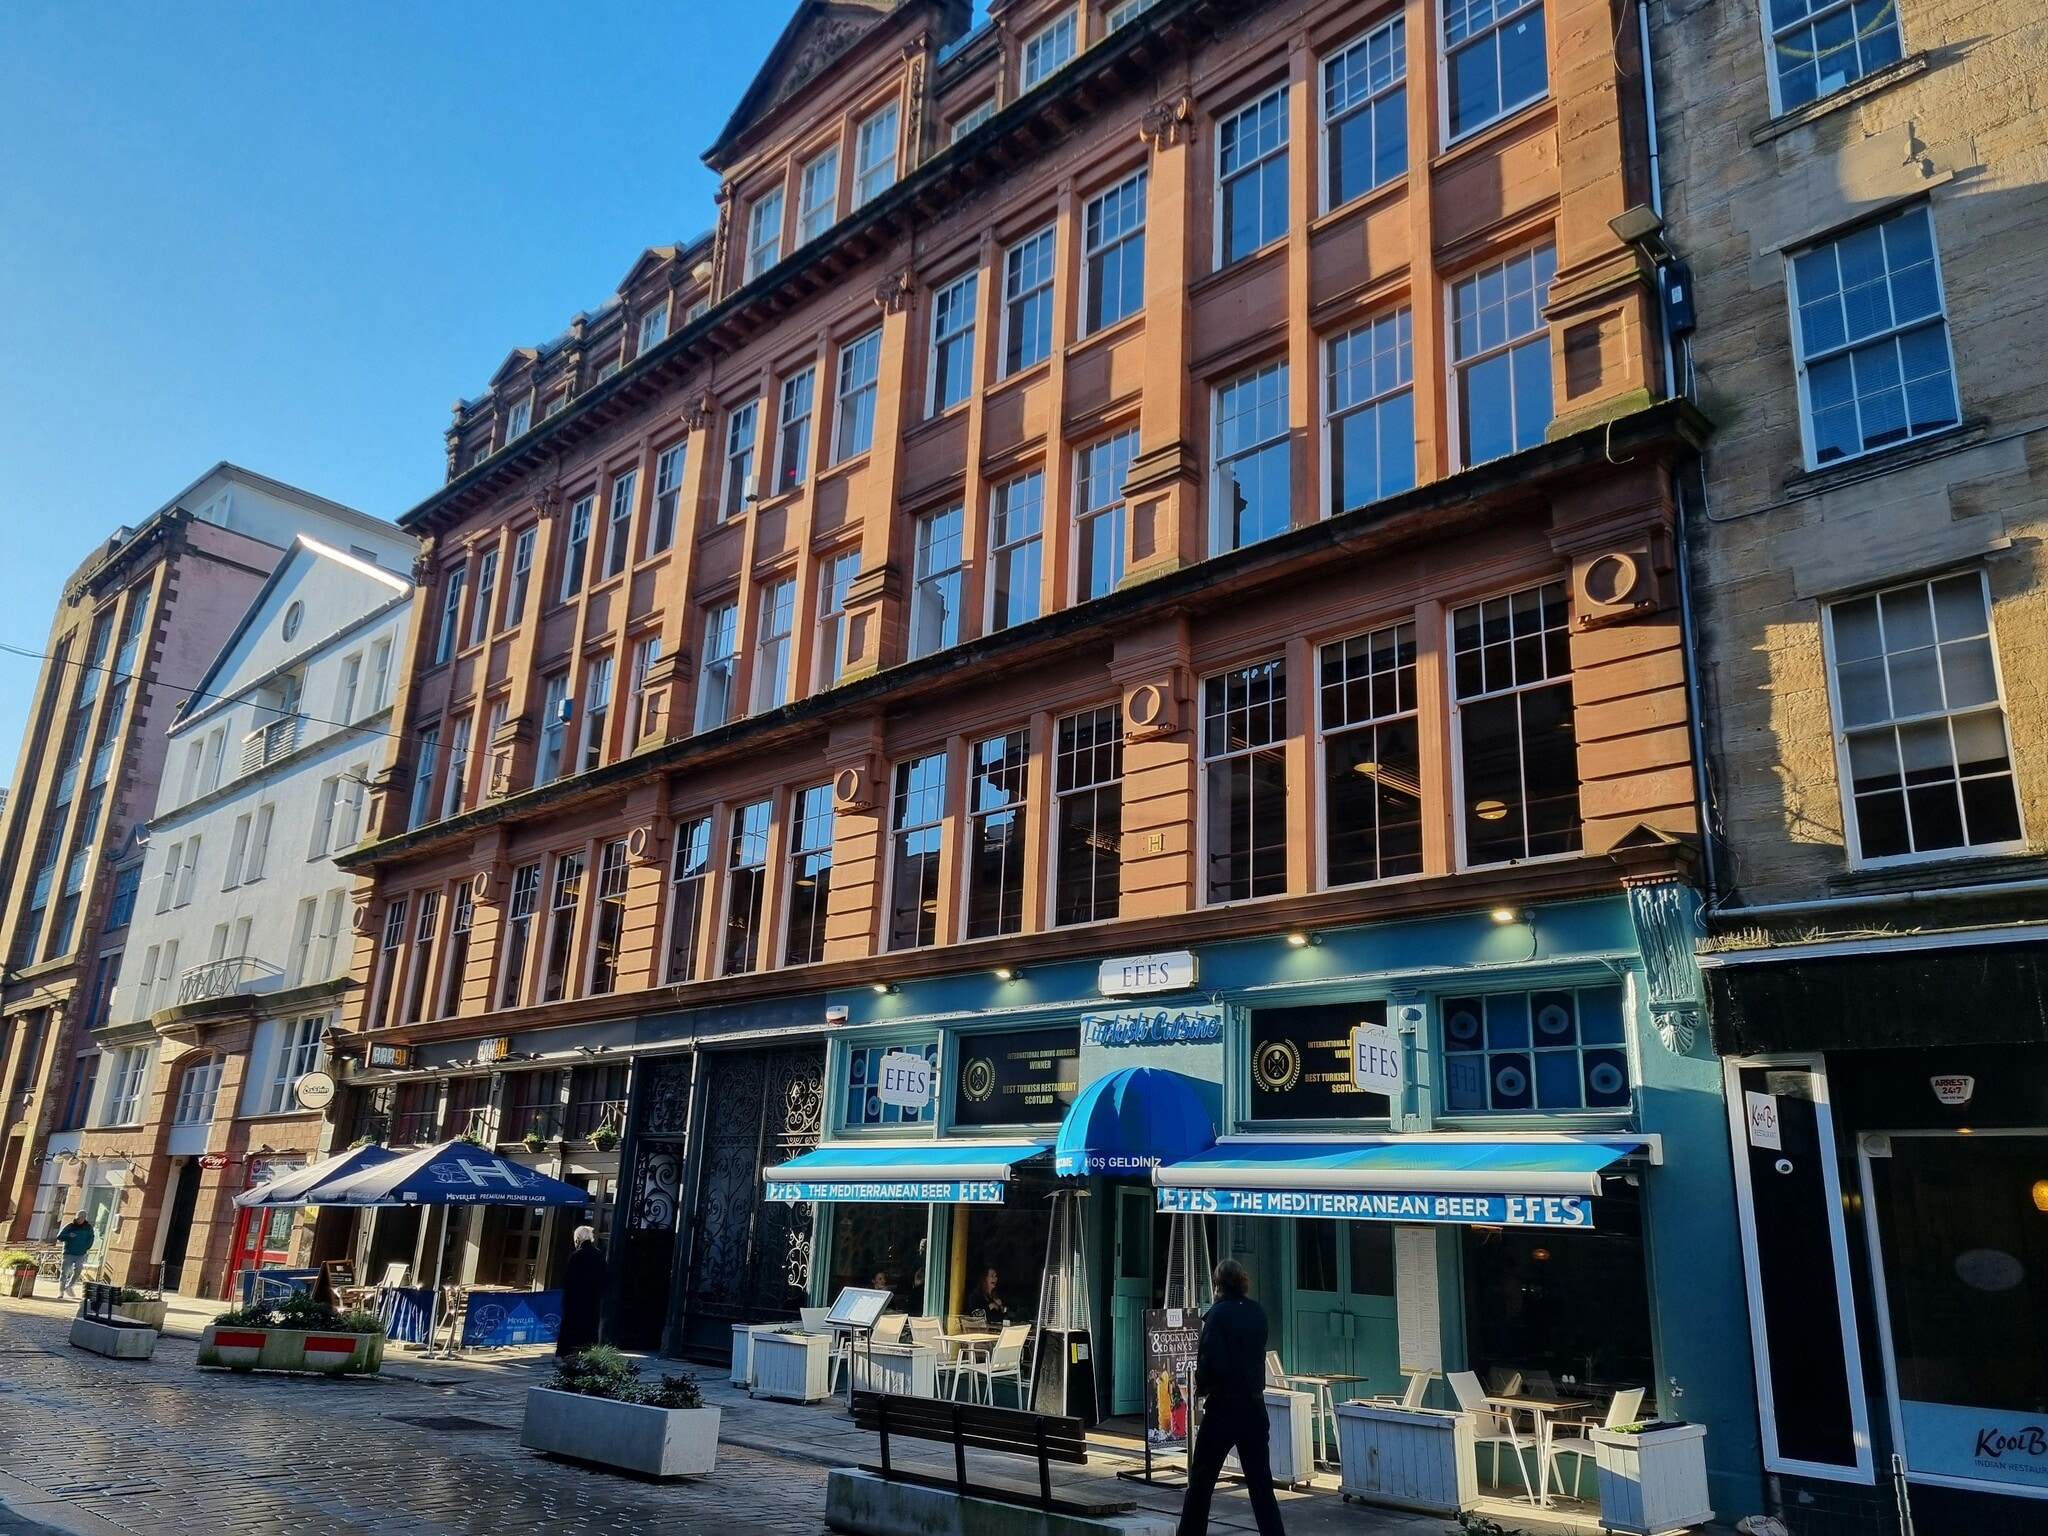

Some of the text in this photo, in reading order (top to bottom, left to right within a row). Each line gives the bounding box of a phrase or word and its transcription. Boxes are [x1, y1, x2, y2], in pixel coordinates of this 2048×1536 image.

[1122, 962, 1169, 987] EFES
[1081, 1011, 1220, 1045] Turkish Cuisine
[1308, 1040, 1346, 1049] INTERNATIONAL
[1007, 1050, 1040, 1059] INTERNATIONAL
[1029, 1060, 1052, 1069] WINNER
[1358, 1043, 1398, 1078] EFES
[884, 1068, 926, 1094] EFES
[1305, 1073, 1350, 1082] BEST TURKISH
[1935, 1079, 1968, 1087] ARREST
[1002, 1082, 1077, 1094] BEST TURKISH RESTAURANT
[1025, 1095, 1054, 1104] SCOTLAND
[769, 1181, 1000, 1200] EFES THE MEDITERRANEAN BEER EFES
[1164, 1188, 1584, 1225] EFES THE MEDITERRANEAN BEER EFES
[1160, 1332, 1199, 1342] COCKTAILS
[1163, 1343, 1193, 1352] DRINKS
[1975, 1460, 2006, 1469] INDIAN
